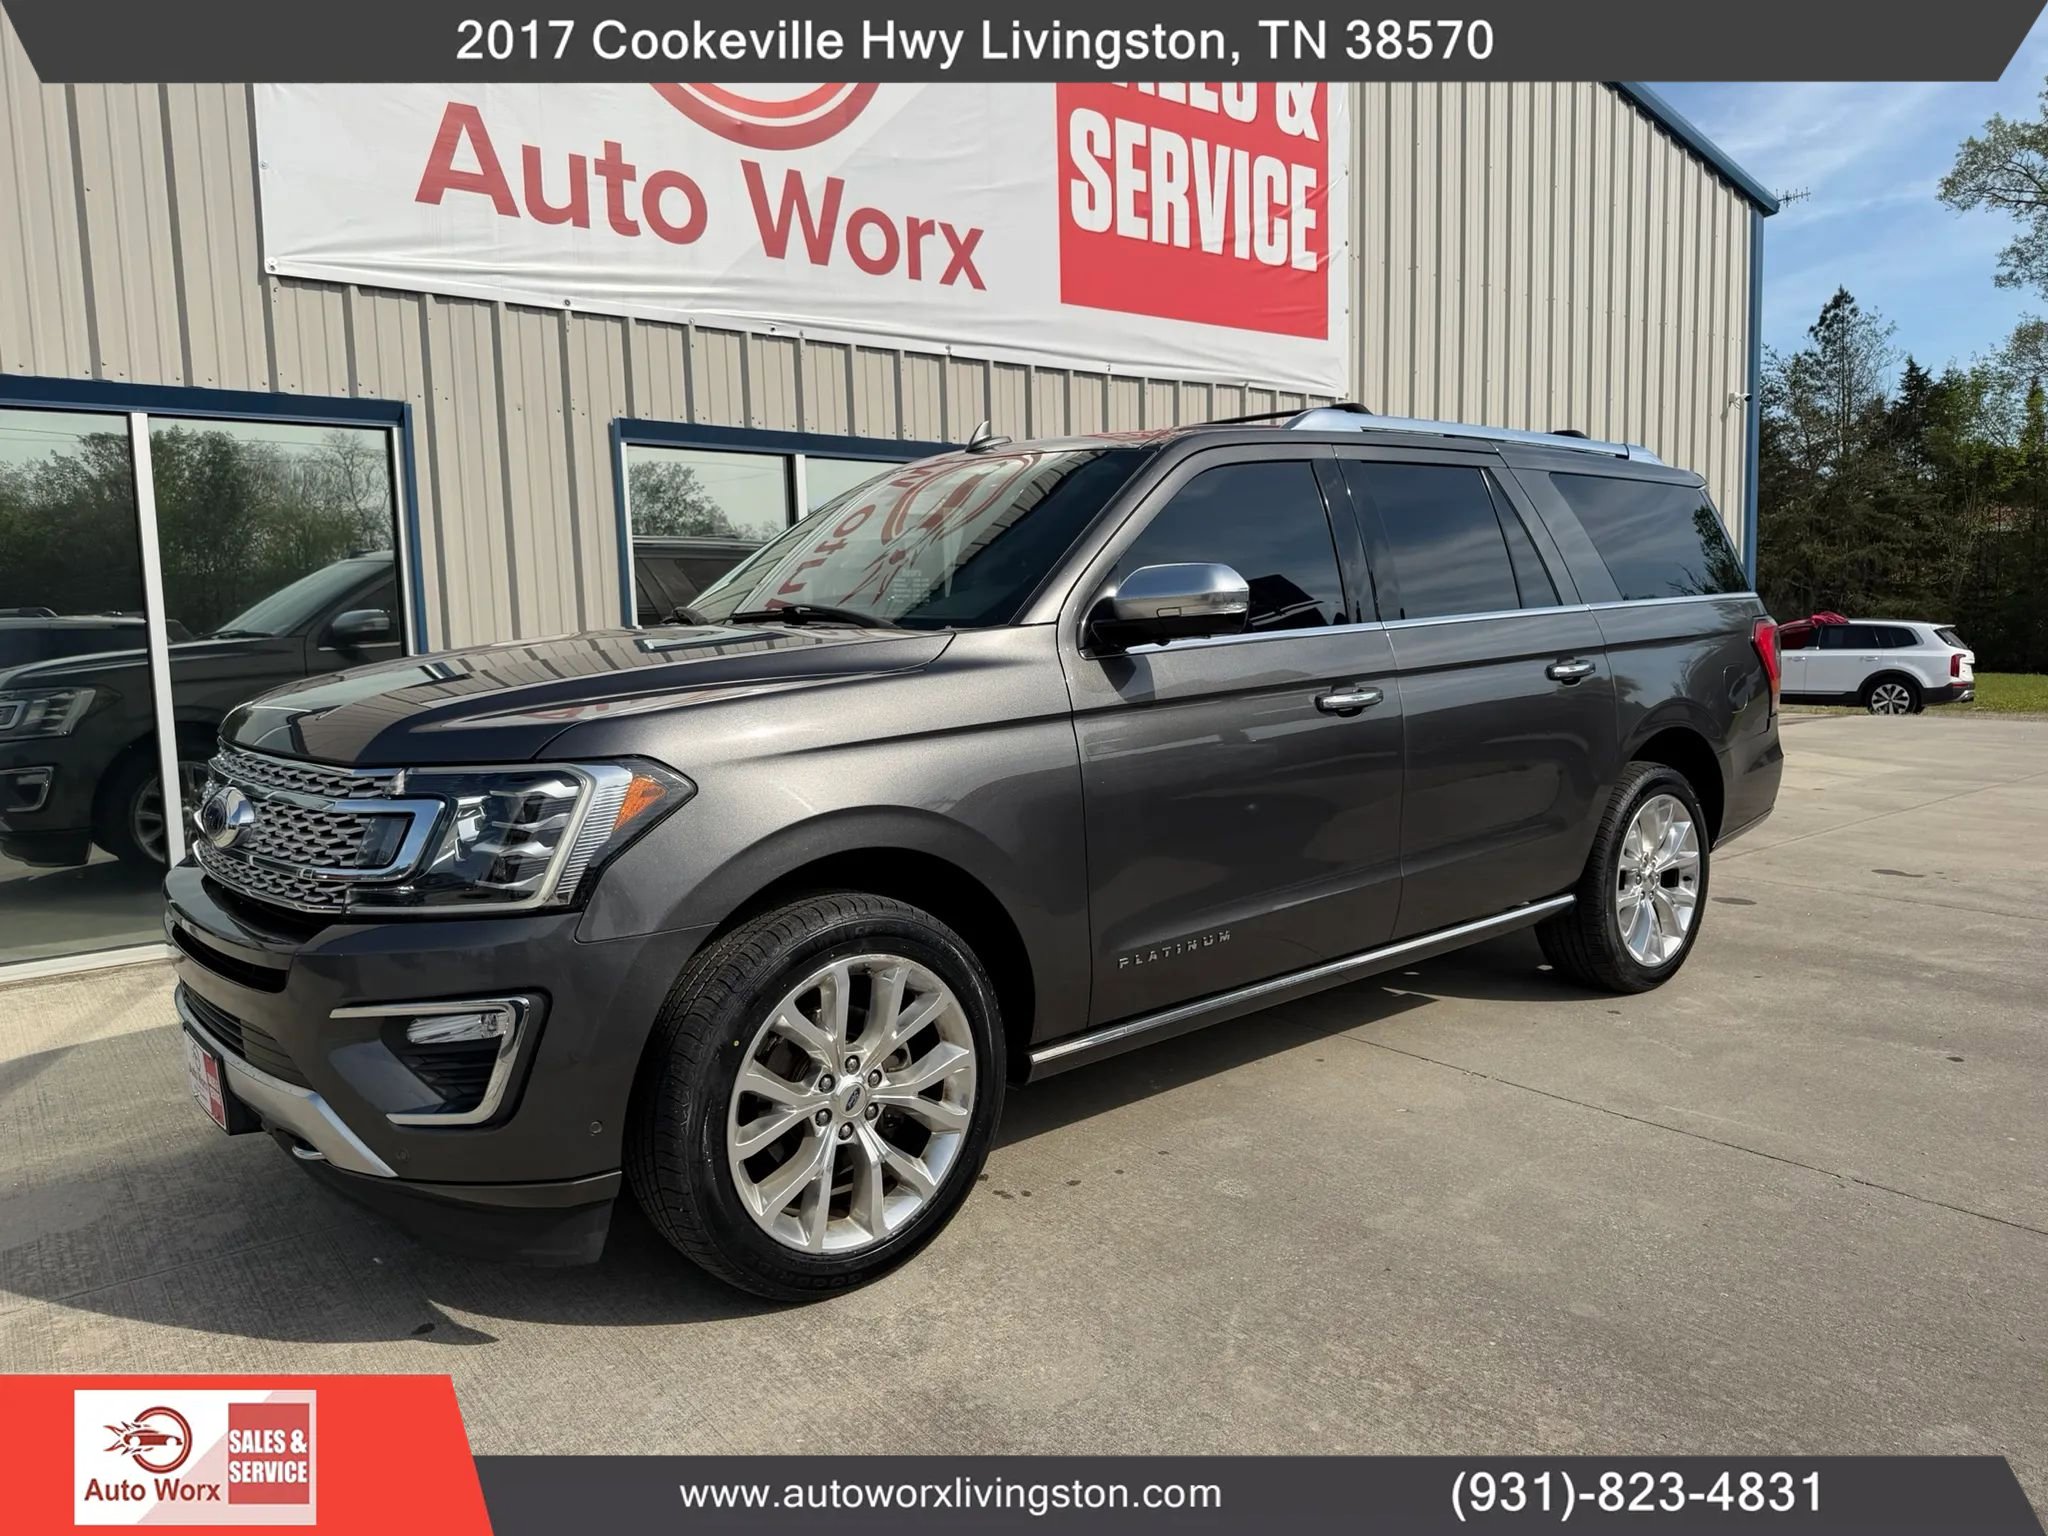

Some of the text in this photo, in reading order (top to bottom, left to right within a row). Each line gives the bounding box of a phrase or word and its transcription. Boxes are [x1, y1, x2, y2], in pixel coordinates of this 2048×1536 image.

[415, 102, 986, 291] Auto Worx
[1069, 107, 1318, 272] SERVICE
[1118, 930, 1231, 969] PLATINUM
